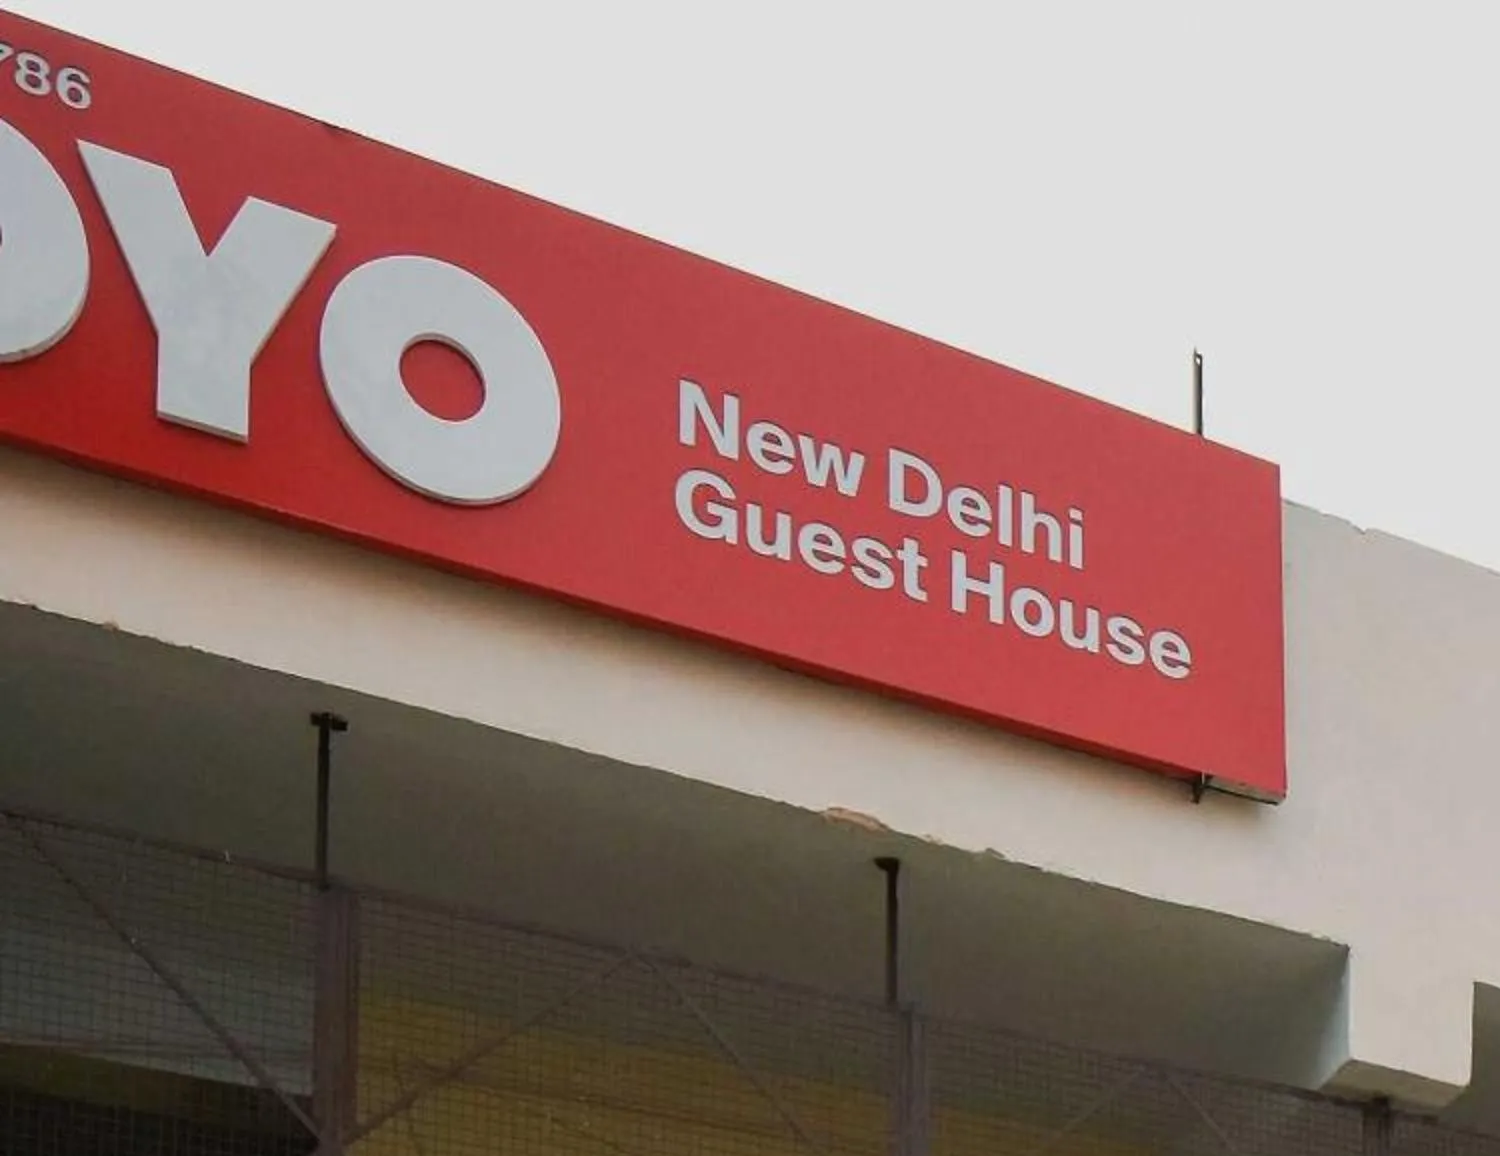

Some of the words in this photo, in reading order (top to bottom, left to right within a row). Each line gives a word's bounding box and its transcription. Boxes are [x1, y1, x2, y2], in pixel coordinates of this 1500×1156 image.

[677, 379, 866, 498] New
[887, 446, 1085, 569] Delhi
[674, 469, 928, 602] Guest
[950, 550, 1193, 680] House
